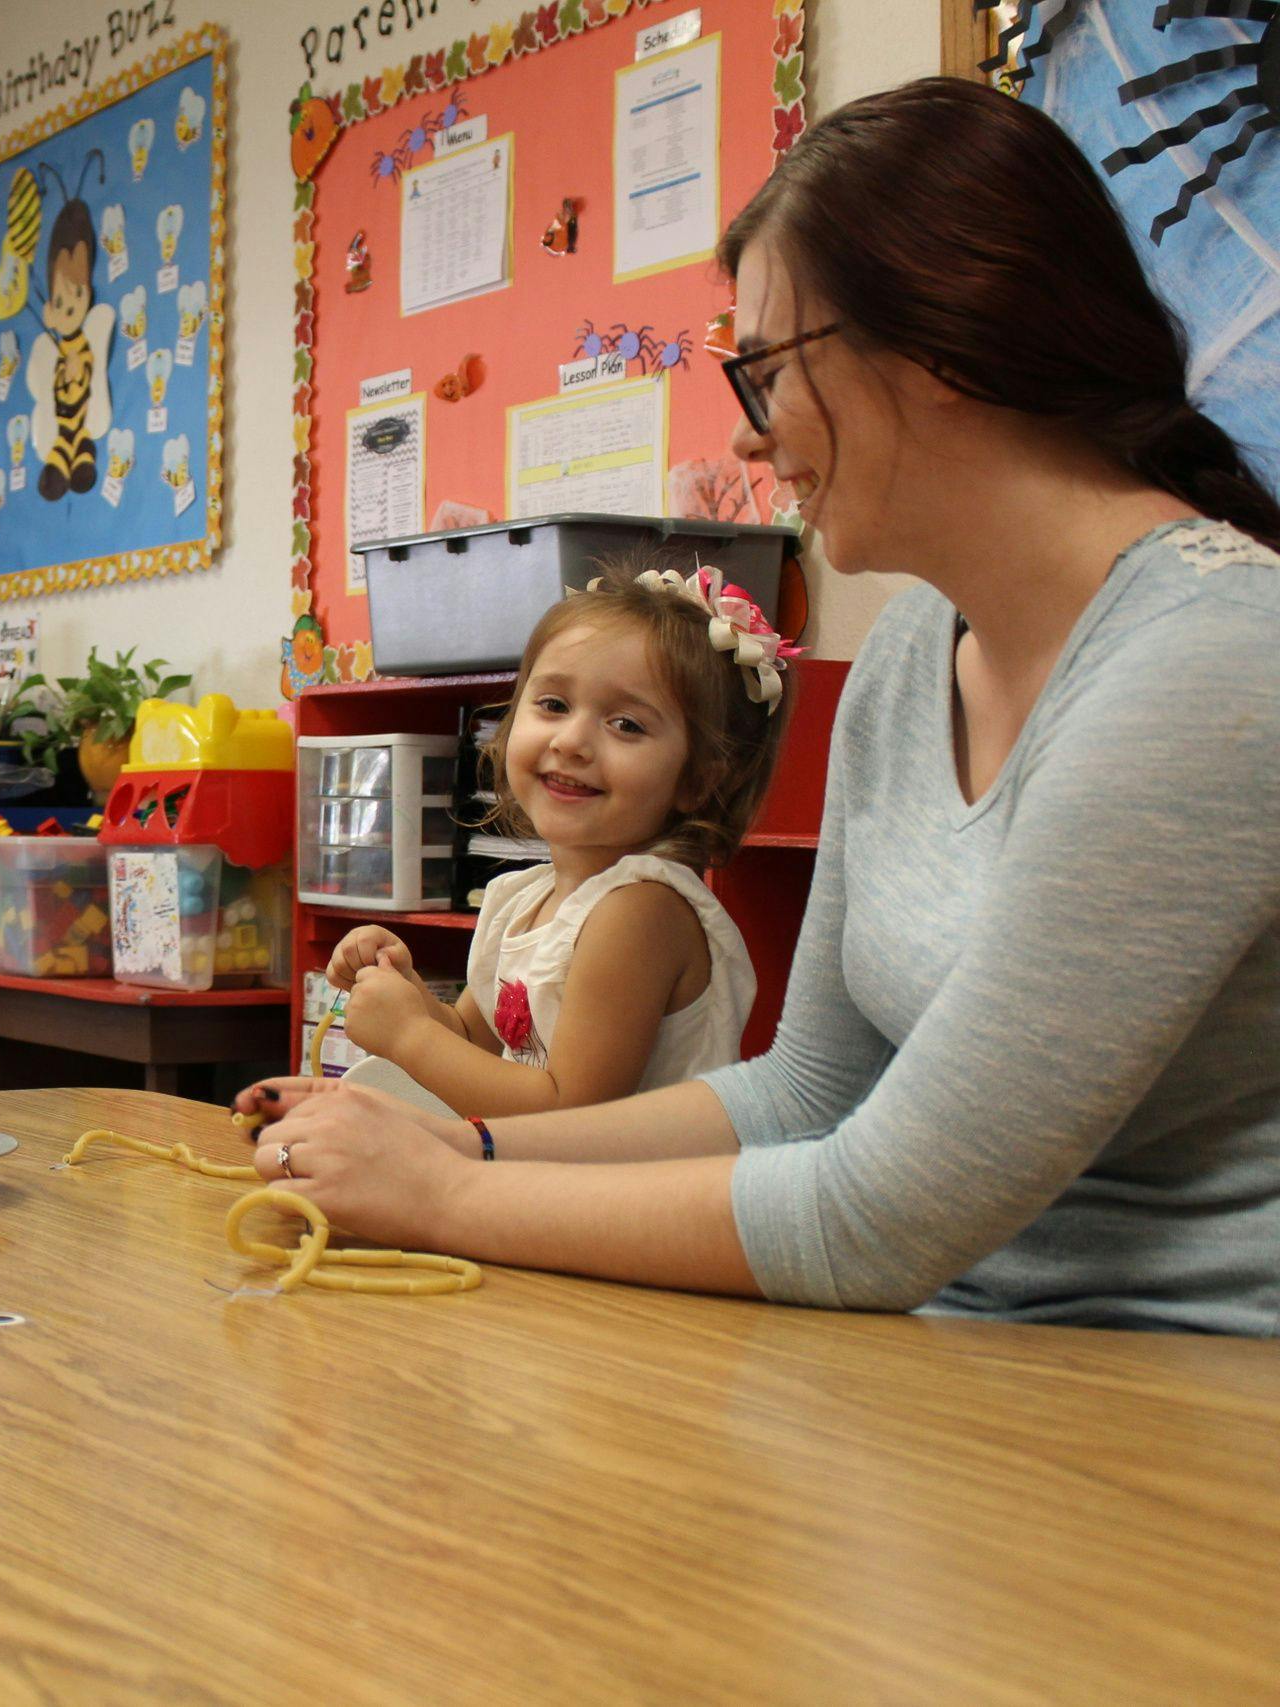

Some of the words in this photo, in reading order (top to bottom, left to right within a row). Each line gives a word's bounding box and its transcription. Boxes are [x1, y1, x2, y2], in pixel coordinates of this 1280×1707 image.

[563, 368, 597, 387] Lesson
[601, 360, 624, 377] Plan
[363, 377, 410, 398] Newsletter
